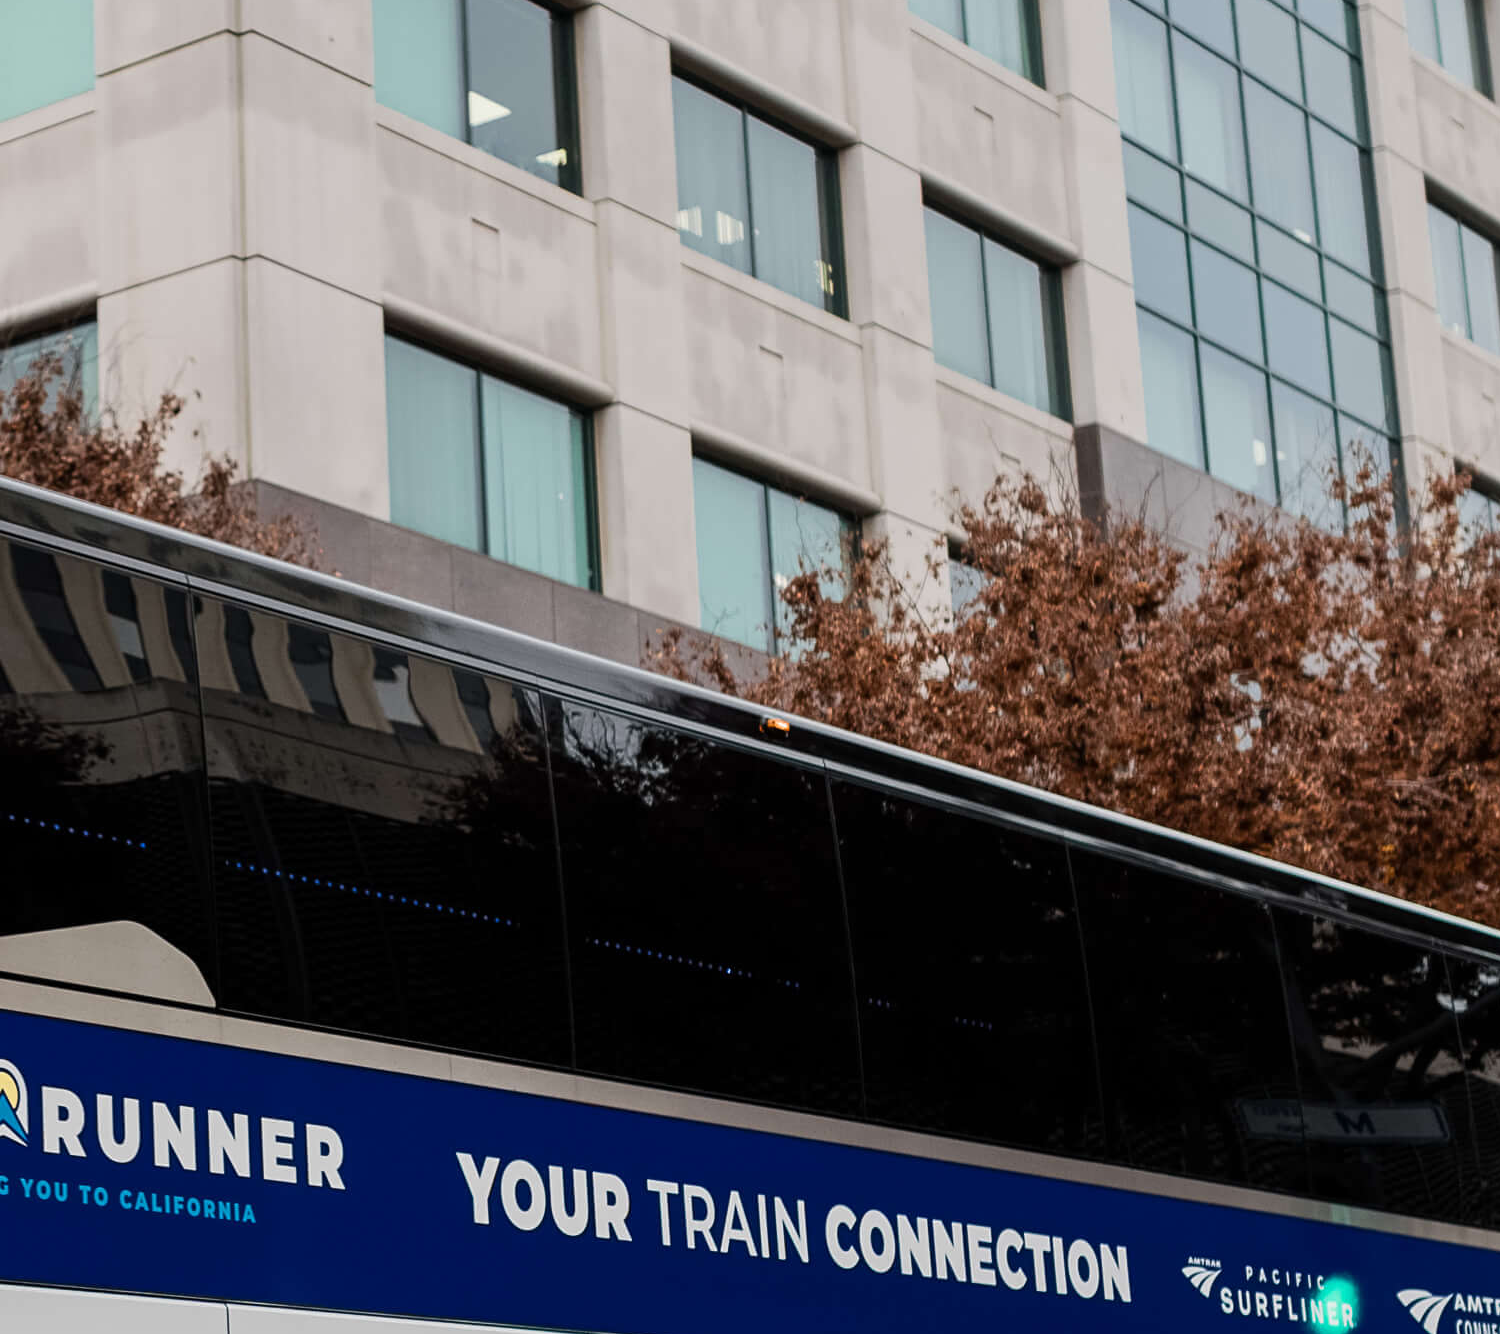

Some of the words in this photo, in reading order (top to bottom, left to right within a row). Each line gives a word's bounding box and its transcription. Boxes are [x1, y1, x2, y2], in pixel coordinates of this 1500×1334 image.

[20, 1178, 69, 1203] YOU
[78, 1184, 109, 1207] TO
[119, 1190, 258, 1224] CALIFORNIA
[455, 1152, 632, 1242] YOUR
[646, 1178, 809, 1263] TRAIN
[825, 1204, 1132, 1302] CONNECTION
[1187, 1256, 1222, 1268] AMTRAK
[1245, 1266, 1325, 1290] PACIFIC
[1220, 1287, 1354, 1328] SURFLINER
